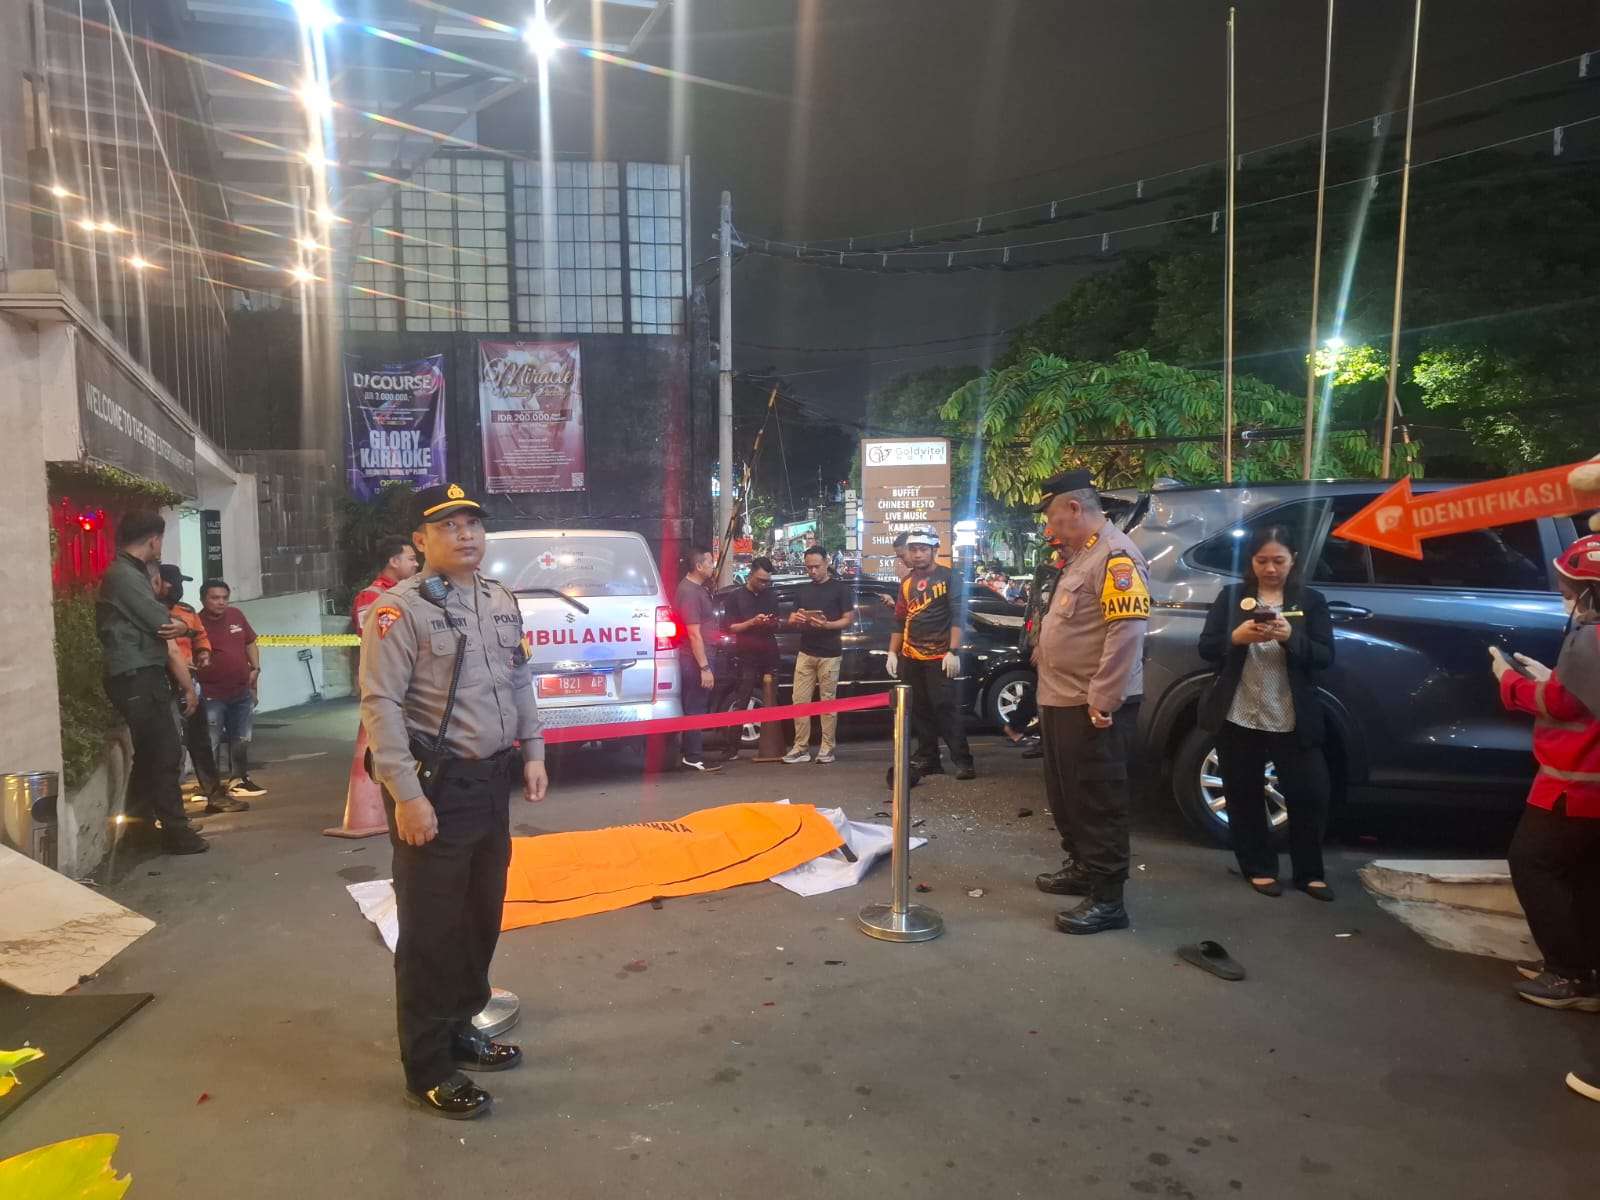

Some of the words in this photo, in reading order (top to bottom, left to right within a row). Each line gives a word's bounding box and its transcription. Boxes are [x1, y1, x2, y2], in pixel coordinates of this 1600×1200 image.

[370, 374, 433, 389] COURSE
[85, 382, 123, 432] WELCOME
[123, 409, 132, 437] TO
[497, 413, 513, 422] IDR
[369, 430, 421, 450] GLORY
[359, 448, 431, 467] KARAOKE
[892, 488, 920, 498] BUFFET
[877, 500, 910, 509] CHINESE
[911, 500, 935, 509] RESTO
[1411, 481, 1563, 528] IDENTIFIKASI
[885, 512, 902, 521] LIVE
[903, 512, 927, 520] MUSIC
[879, 559, 895, 568] SKY
[525, 626, 641, 646] MBULANCE
[560, 677, 580, 689] 1821
